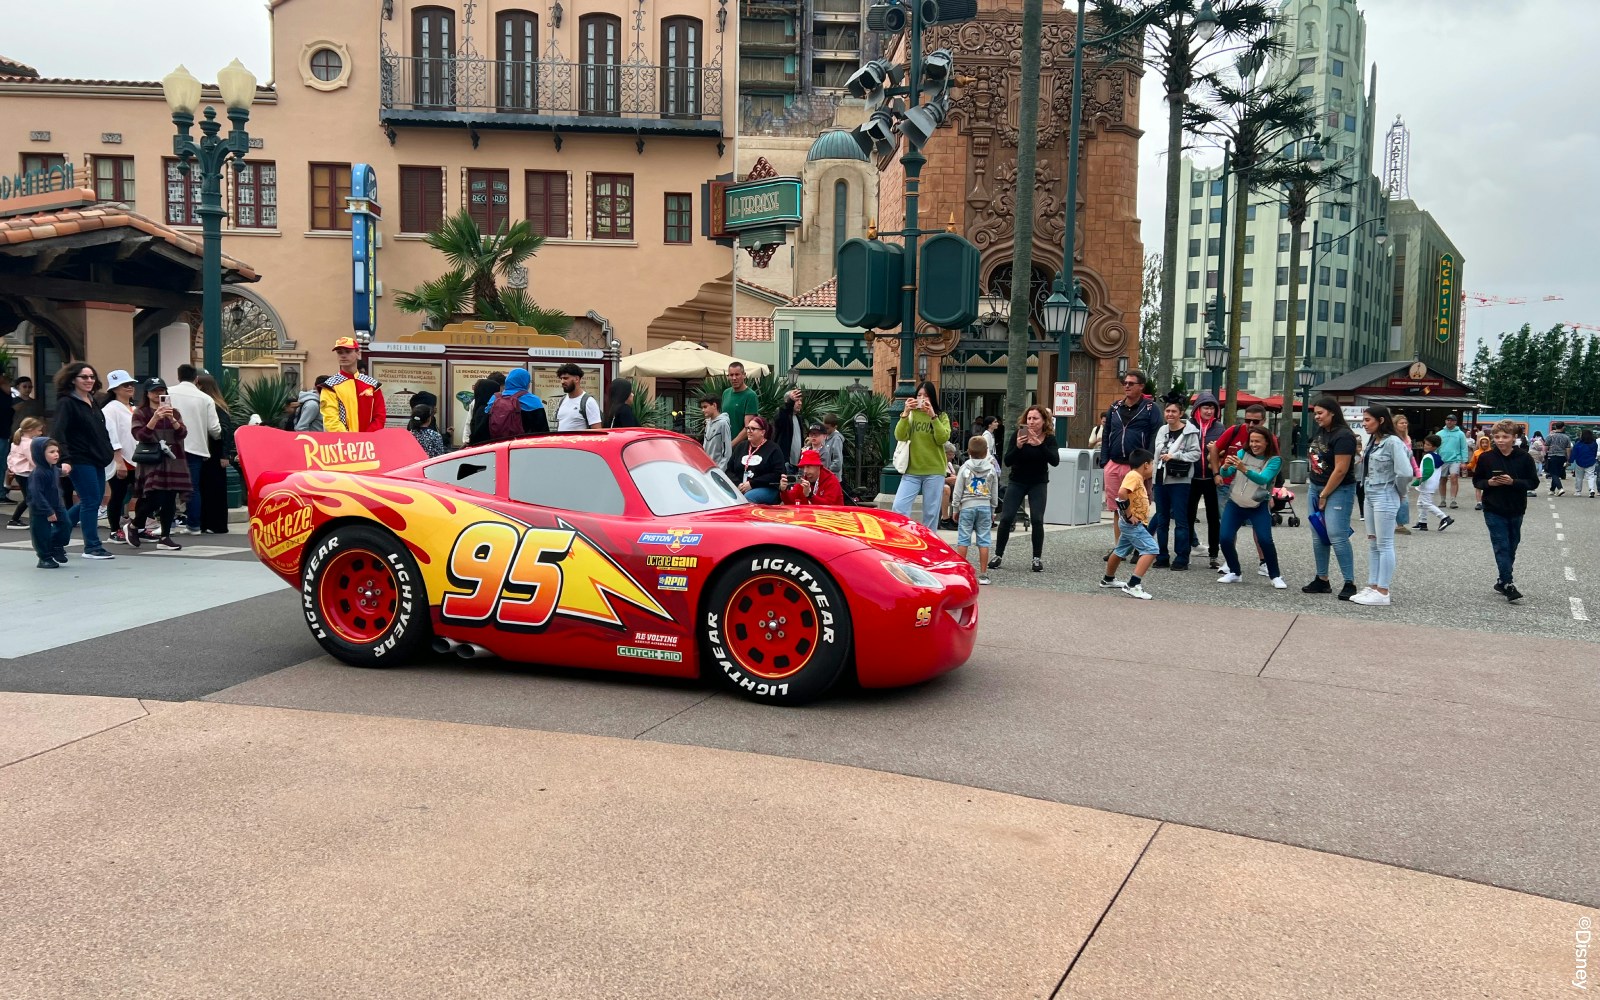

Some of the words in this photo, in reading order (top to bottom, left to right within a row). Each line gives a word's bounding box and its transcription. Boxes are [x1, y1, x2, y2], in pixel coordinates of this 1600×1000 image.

[1390, 137, 1401, 192] CAPITAN
[1440, 269, 1450, 335] CAPITAN
[442, 521, 577, 631] 95
[641, 534, 672, 542] PISTON
[304, 536, 339, 639] LIGHTYEAR
[373, 553, 413, 658] LIGHTYEAR
[751, 558, 835, 644] LIGHTYEAR
[914, 606, 932, 627] 95
[707, 612, 789, 696] LIGHTYEAR
